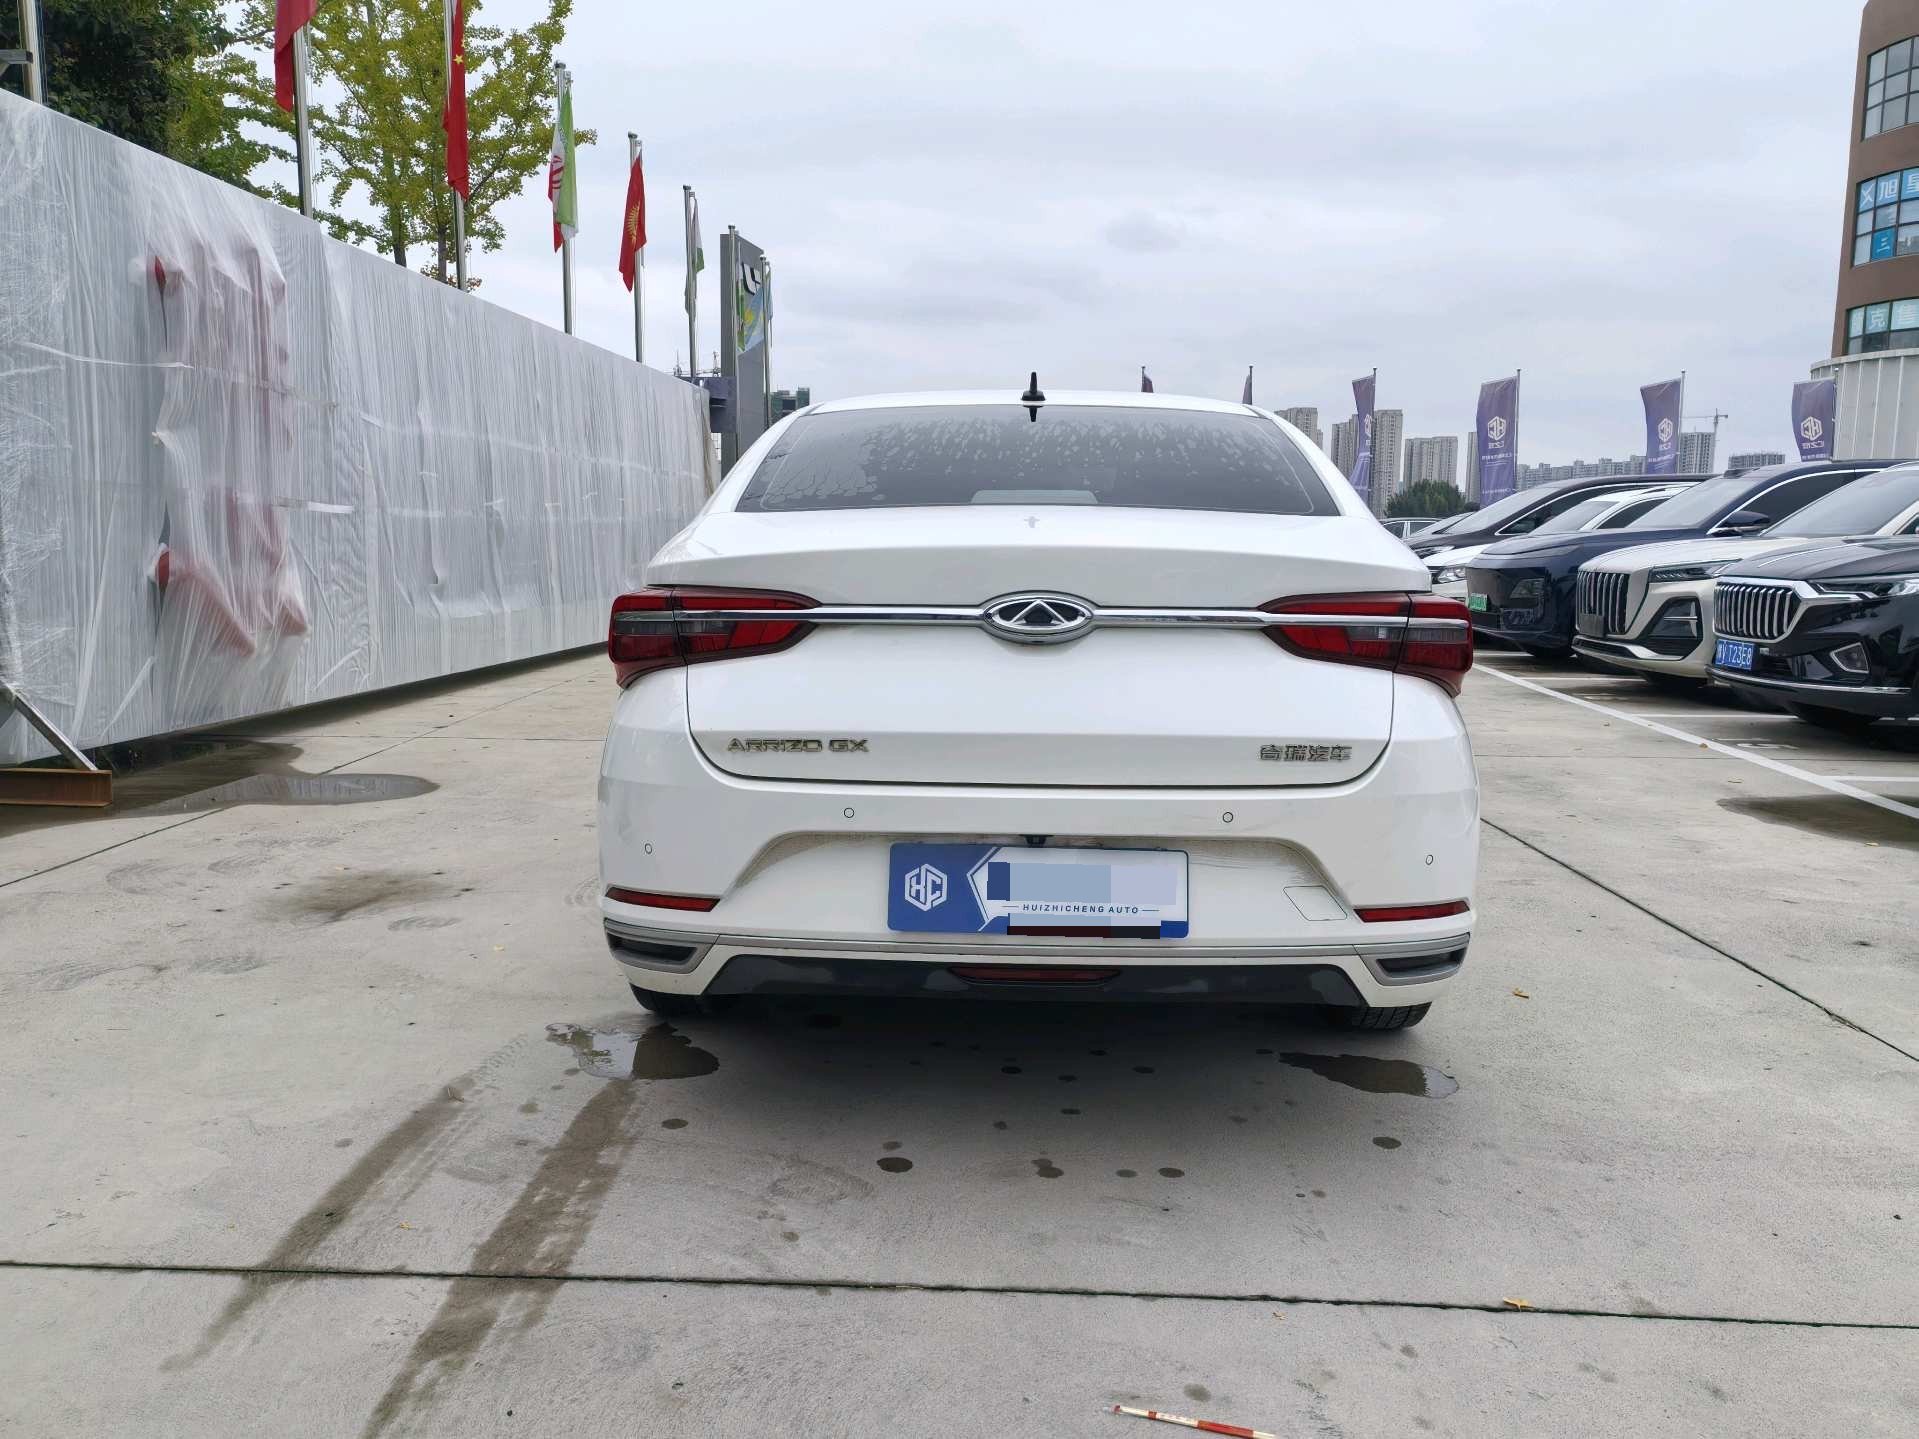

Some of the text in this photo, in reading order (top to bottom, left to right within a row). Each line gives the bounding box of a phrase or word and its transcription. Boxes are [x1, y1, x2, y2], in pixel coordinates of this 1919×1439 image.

[727, 737, 870, 753] ARRIZO GX
[1260, 743, 1353, 763] 奇瑞汽车
[1022, 903, 1139, 915] HUIZHICHENG AUTO
